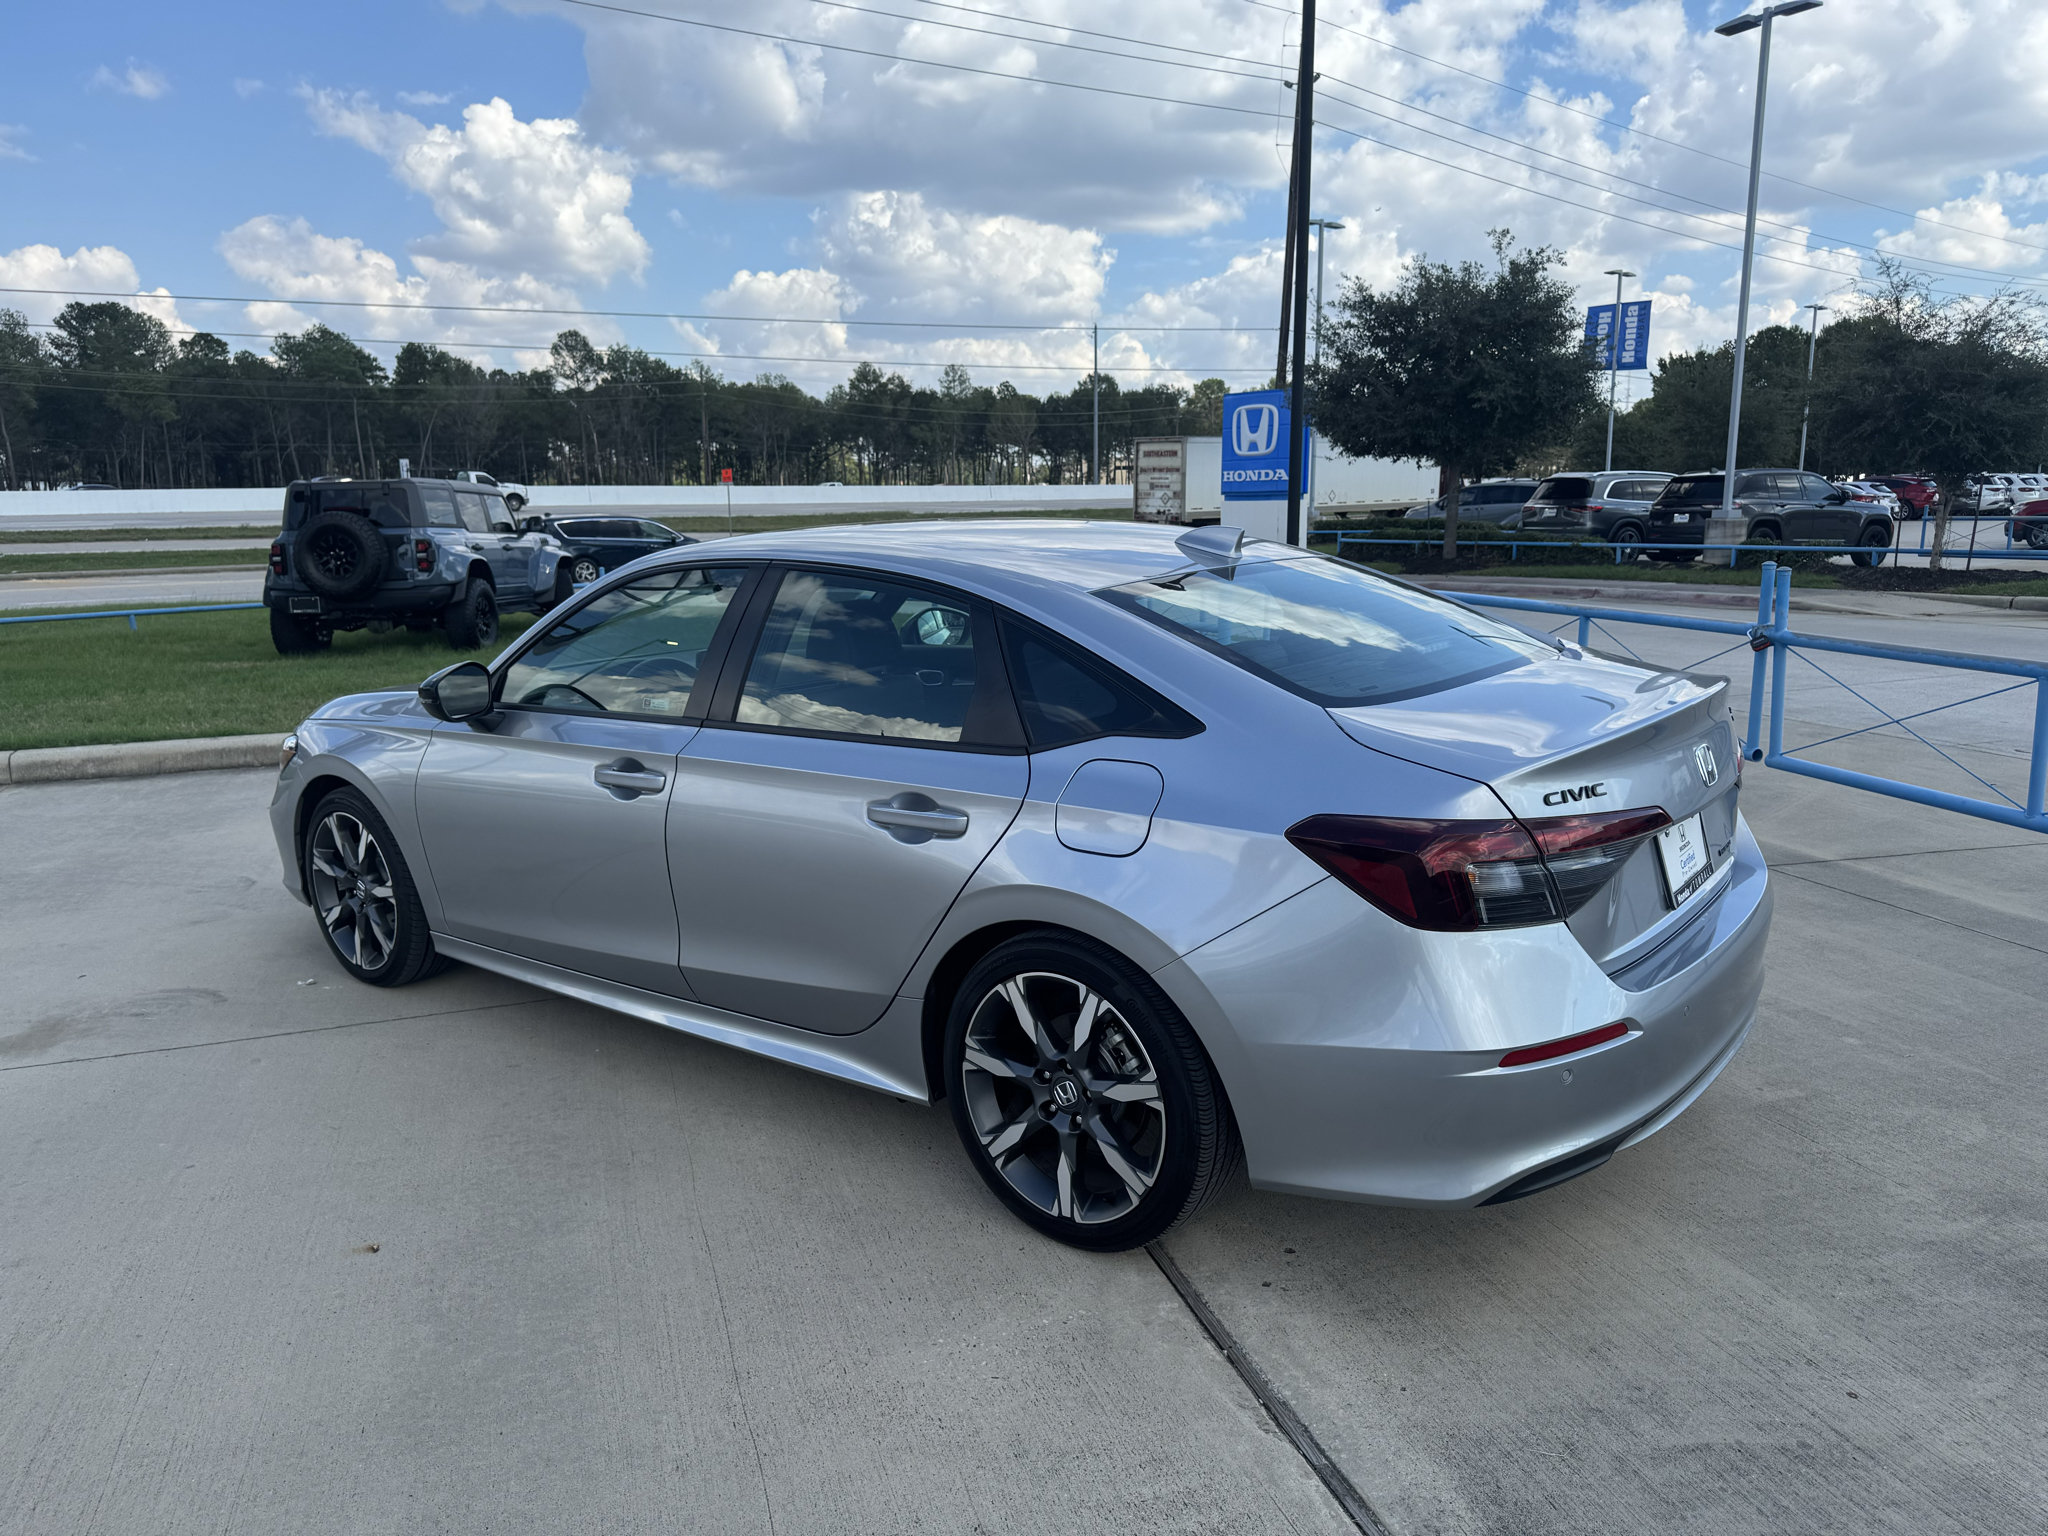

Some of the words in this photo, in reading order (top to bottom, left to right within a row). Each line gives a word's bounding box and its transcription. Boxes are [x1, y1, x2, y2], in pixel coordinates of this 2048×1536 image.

[1622, 305, 1638, 363] Honda
[1223, 469, 1289, 482] HONDA
[1543, 783, 1607, 806] CIVIC
[1680, 850, 1695, 870] Certified
[1677, 888, 1691, 904] Honda
